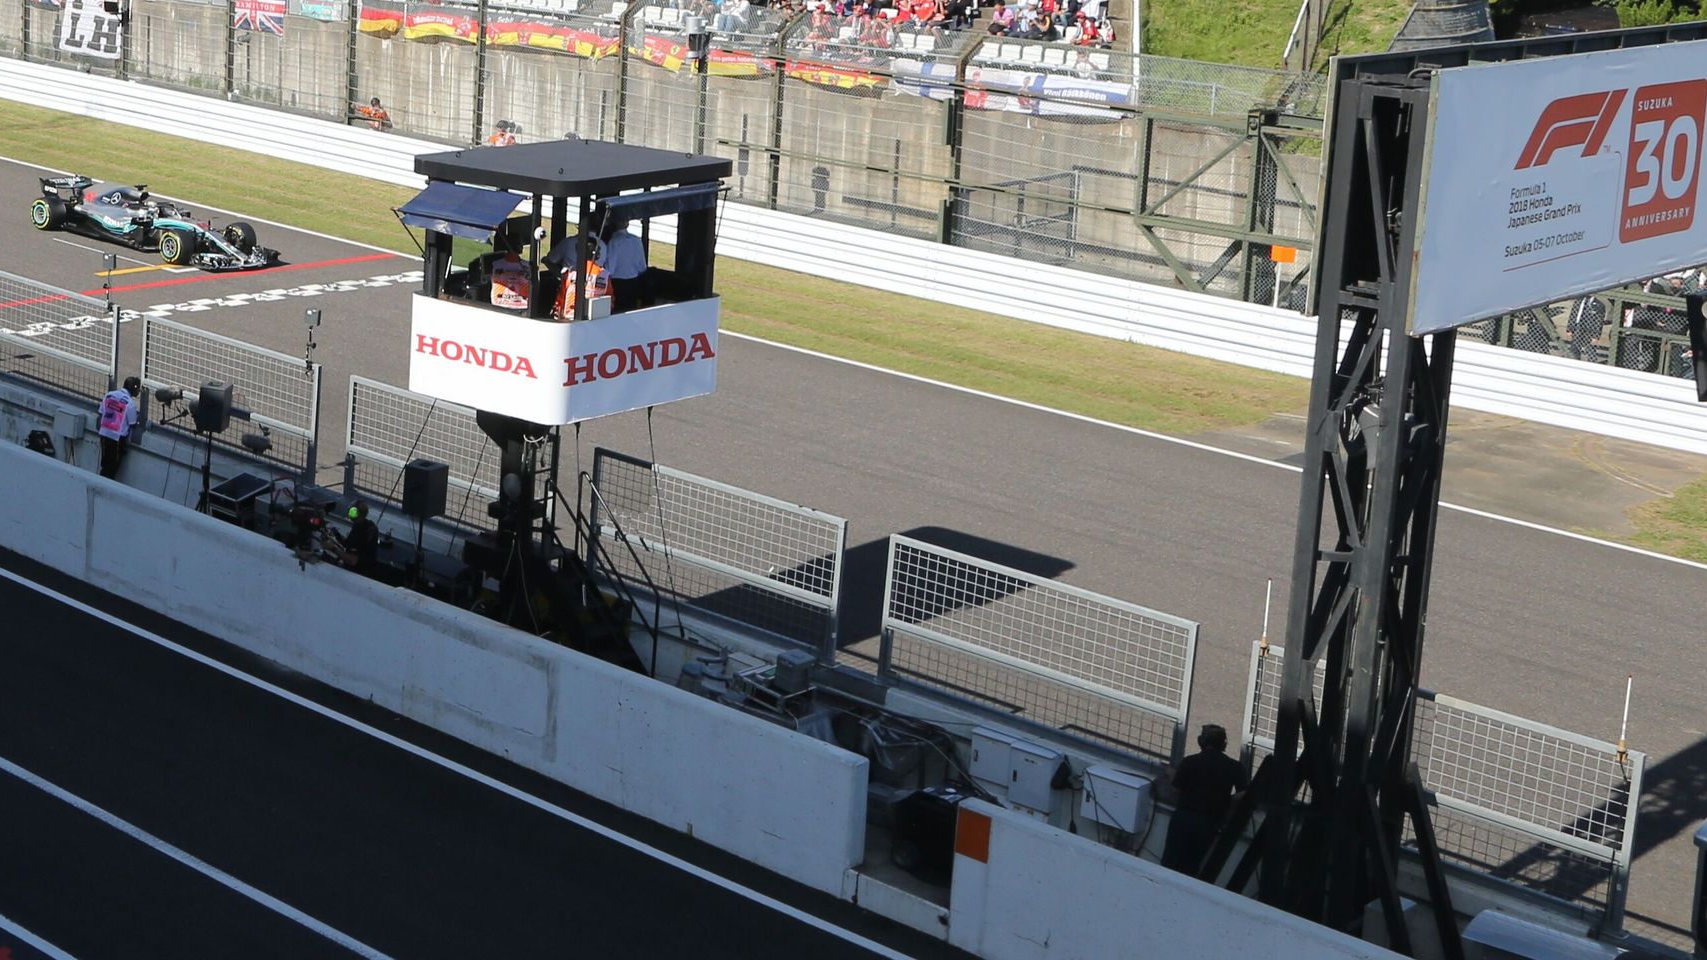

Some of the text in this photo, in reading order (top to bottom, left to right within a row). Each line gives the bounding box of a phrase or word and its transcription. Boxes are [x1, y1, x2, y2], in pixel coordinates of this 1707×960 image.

[65, 12, 120, 54] LH
[1638, 97, 1673, 112] SUZUKA
[1514, 88, 1629, 170] F1
[1628, 115, 1698, 207] 30
[1510, 182, 1546, 199] Formula 1
[1507, 202, 1581, 229] Japanese Grand Prix
[1509, 195, 1553, 214] 2018 Honda
[1625, 207, 1690, 229] ANNIVERSARY
[1504, 230, 1586, 257] Suzuka 05-07 October
[416, 334, 538, 379] HONDA
[563, 332, 715, 387] HONDA
